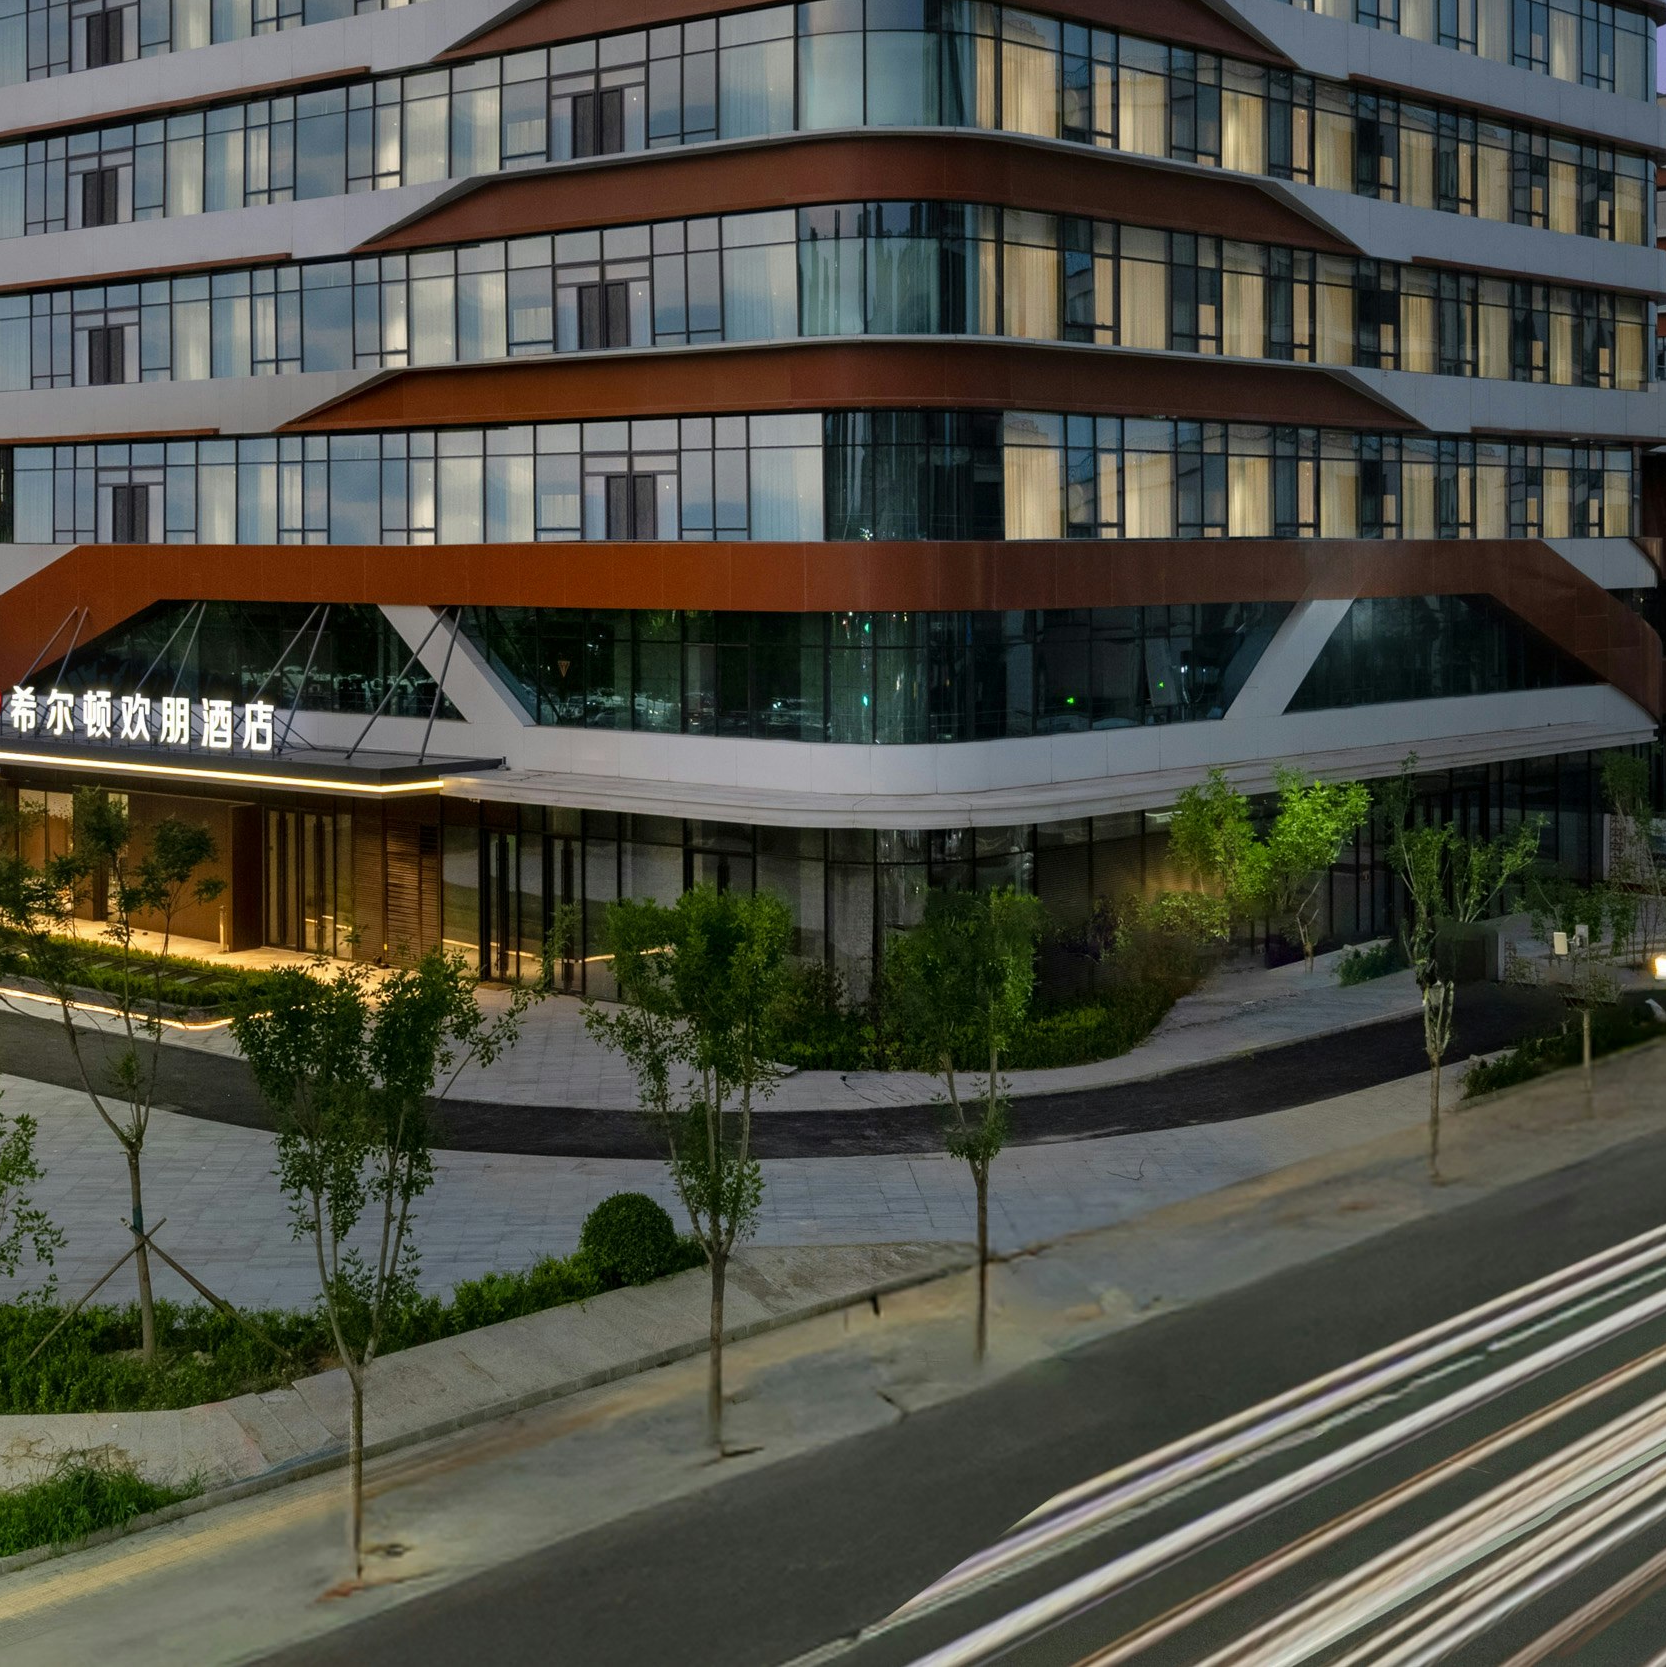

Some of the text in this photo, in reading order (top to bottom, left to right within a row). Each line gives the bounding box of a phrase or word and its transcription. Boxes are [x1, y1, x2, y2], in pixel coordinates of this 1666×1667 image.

[10, 685, 275, 751] 希尔顿欢朋酒店
